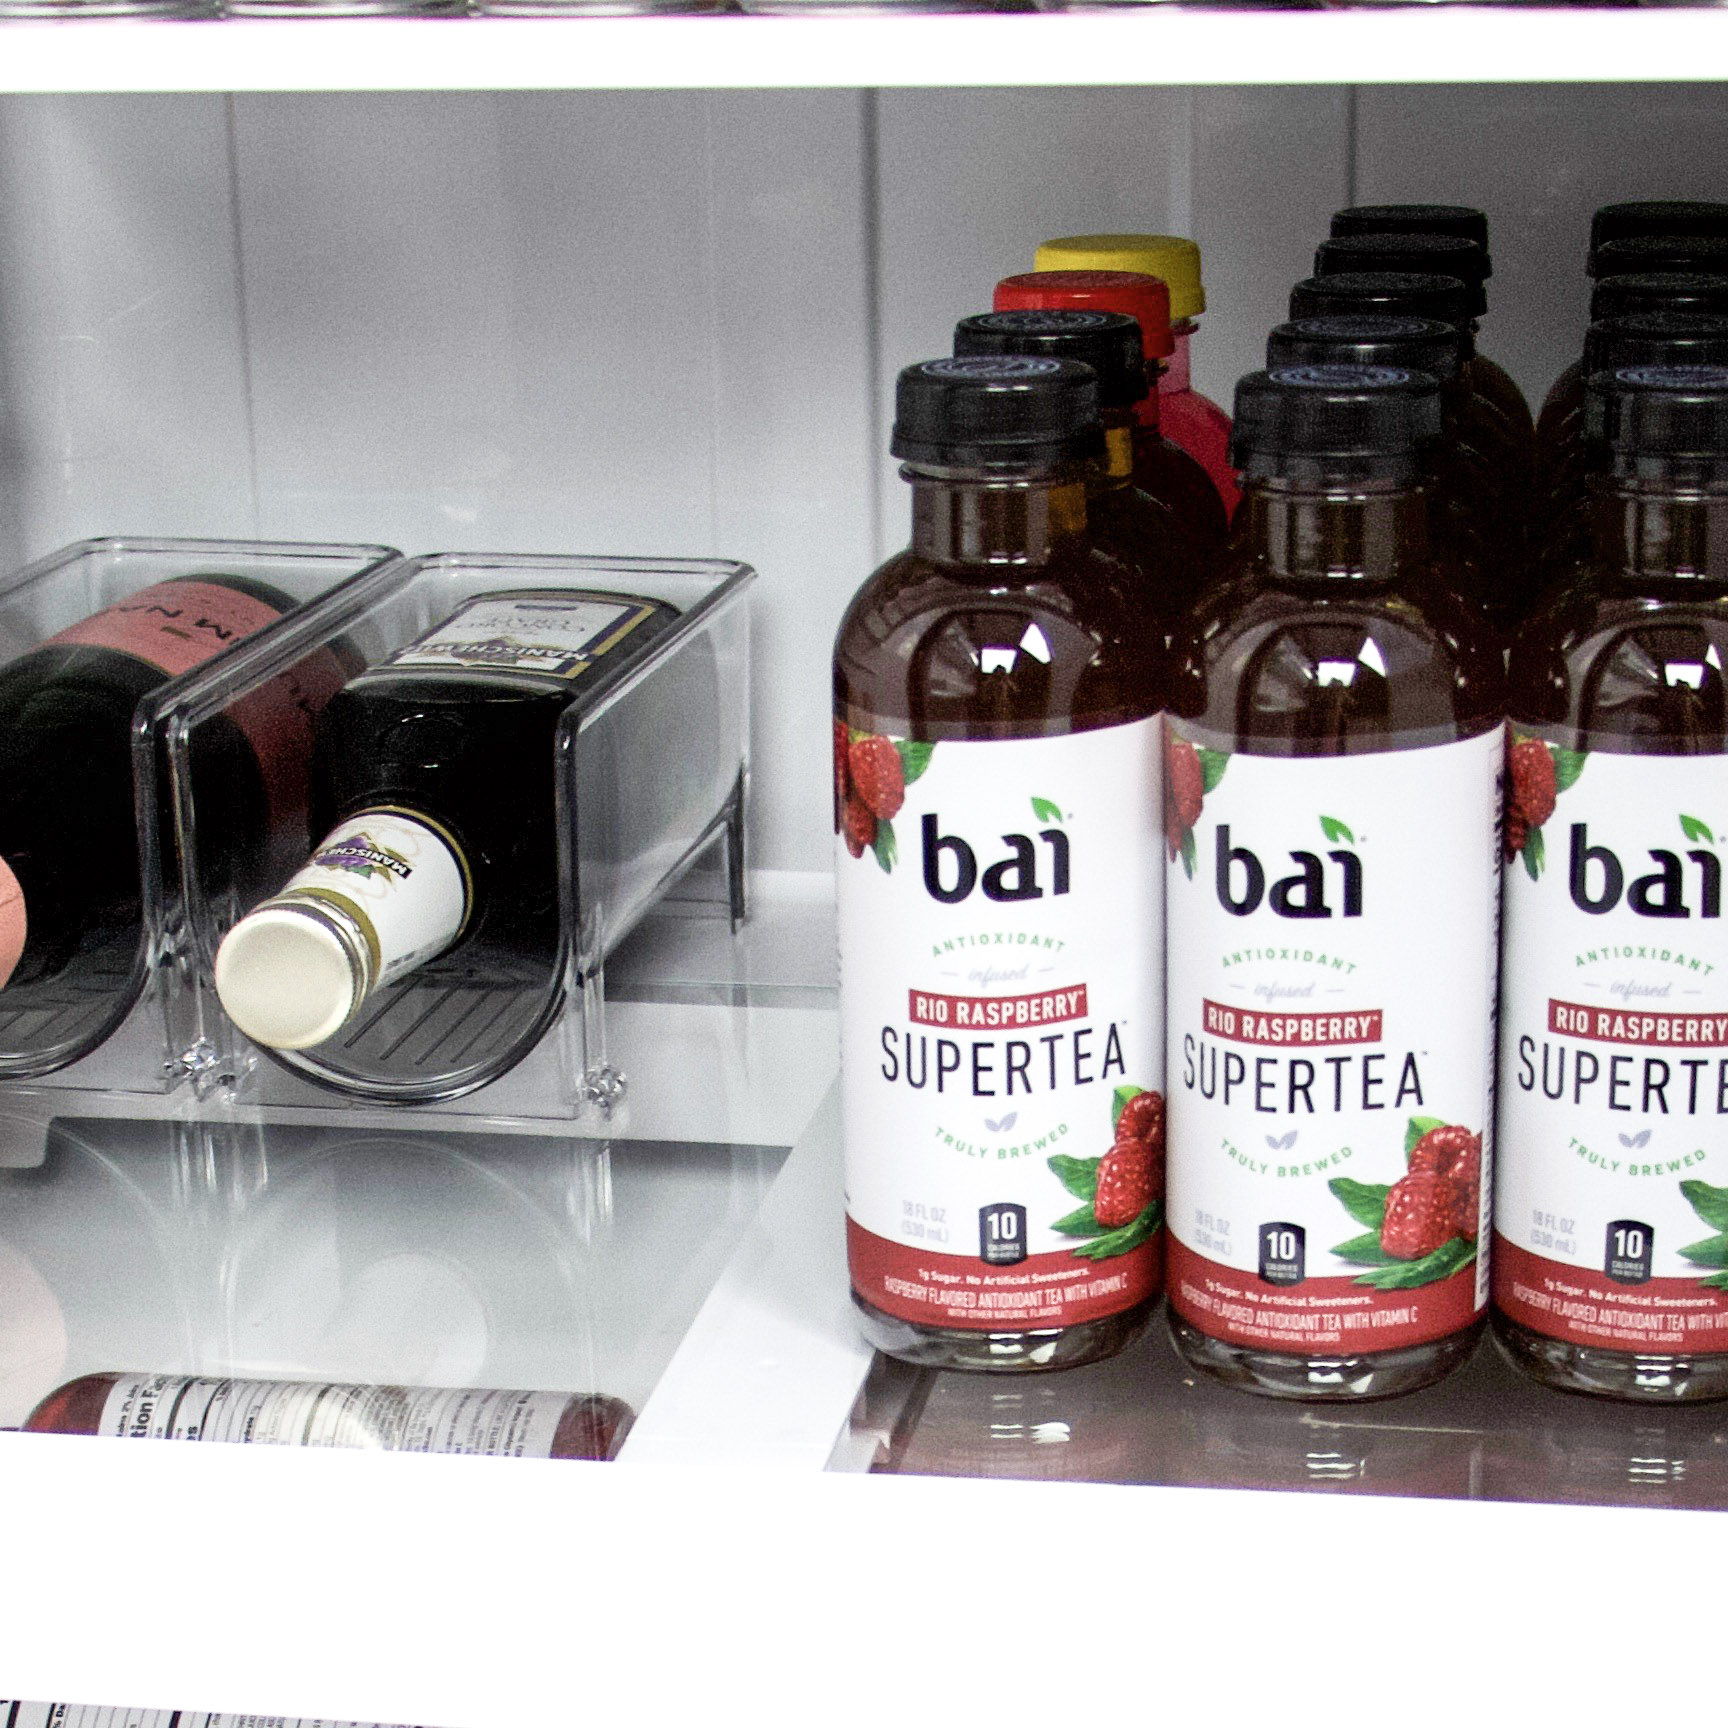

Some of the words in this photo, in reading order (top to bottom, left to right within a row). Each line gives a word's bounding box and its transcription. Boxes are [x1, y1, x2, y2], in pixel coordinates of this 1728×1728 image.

[921, 797, 1071, 904] bai
[1215, 814, 1363, 918] bai
[1569, 813, 1722, 918] bai
[932, 932, 1067, 957] ANTIOXIDANT
[1222, 948, 1357, 975] ANTIOXIDANT
[1575, 946, 1715, 976] ANTIOXIDANT
[915, 996, 949, 1023] RIO
[1207, 1006, 1236, 1035] RIO
[1555, 1006, 1590, 1034] RIO
[935, 1126, 988, 1159] TRULY
[997, 1122, 1069, 1159] BREWED
[1220, 1138, 1268, 1174] TRULY
[1276, 1145, 1353, 1177] BREWED
[1568, 1137, 1620, 1173] TRULY
[1629, 1148, 1706, 1176] BREWED
[987, 1211, 1018, 1240] 10
[1266, 1231, 1296, 1260] 10
[1614, 1229, 1644, 1258] 10
[966, 1274, 982, 1285] No
